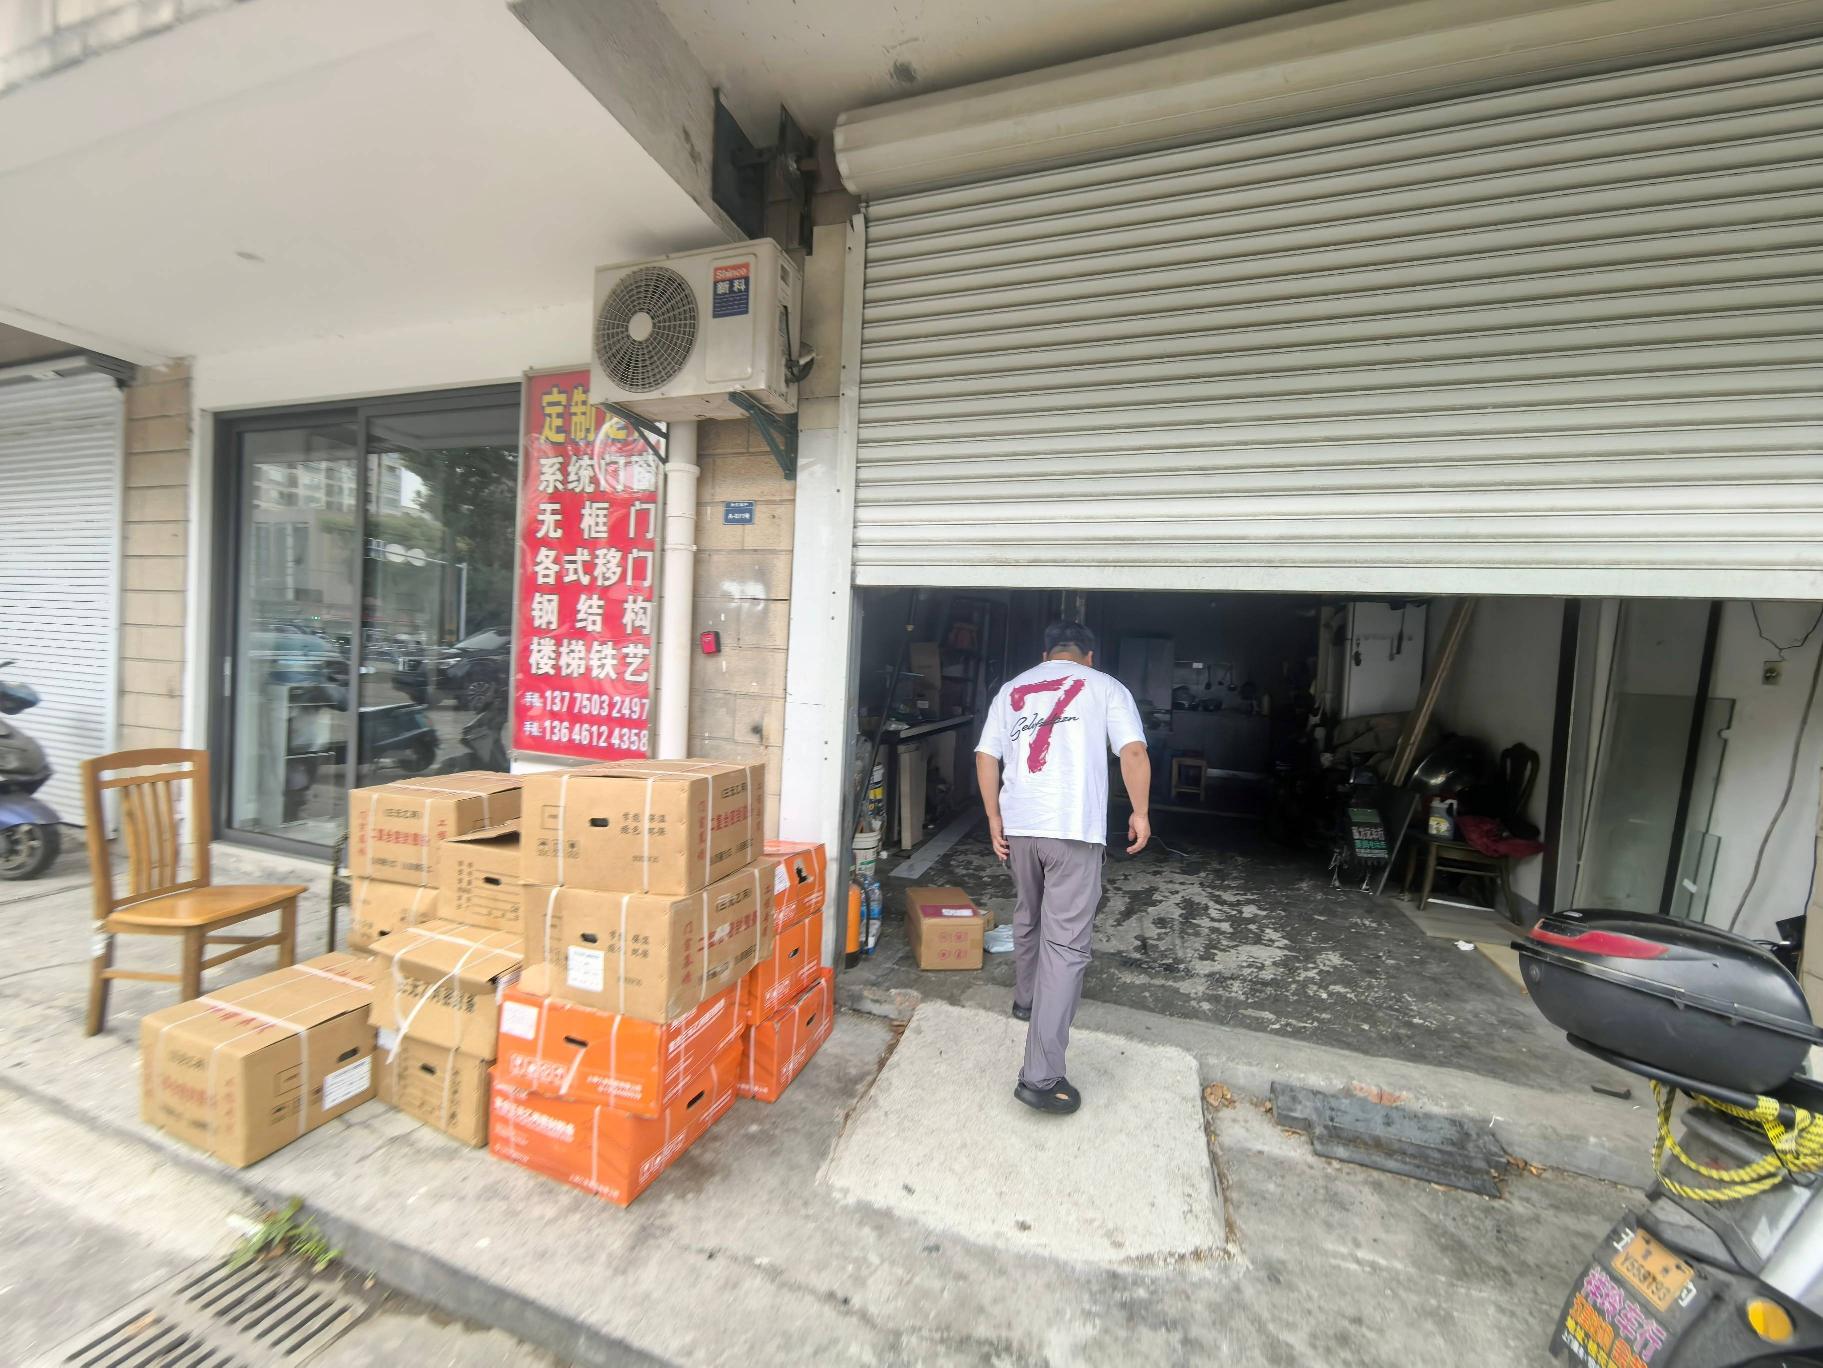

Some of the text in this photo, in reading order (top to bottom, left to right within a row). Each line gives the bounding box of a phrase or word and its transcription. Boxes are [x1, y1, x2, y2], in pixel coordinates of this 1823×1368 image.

[538, 453, 658, 493] 系统门窗
[536, 500, 657, 540] 无框门
[533, 546, 654, 588] 各式移门
[531, 592, 652, 635] 钢结构
[528, 637, 651, 682] 楼梯铁艺
[545, 690, 570, 713] 137
[573, 693, 609, 716] 7503
[611, 696, 649, 720] 2497
[1010, 674, 1087, 774] 7
[544, 720, 570, 742] 136
[571, 724, 609, 747] 4612
[611, 728, 649, 751] 4358
